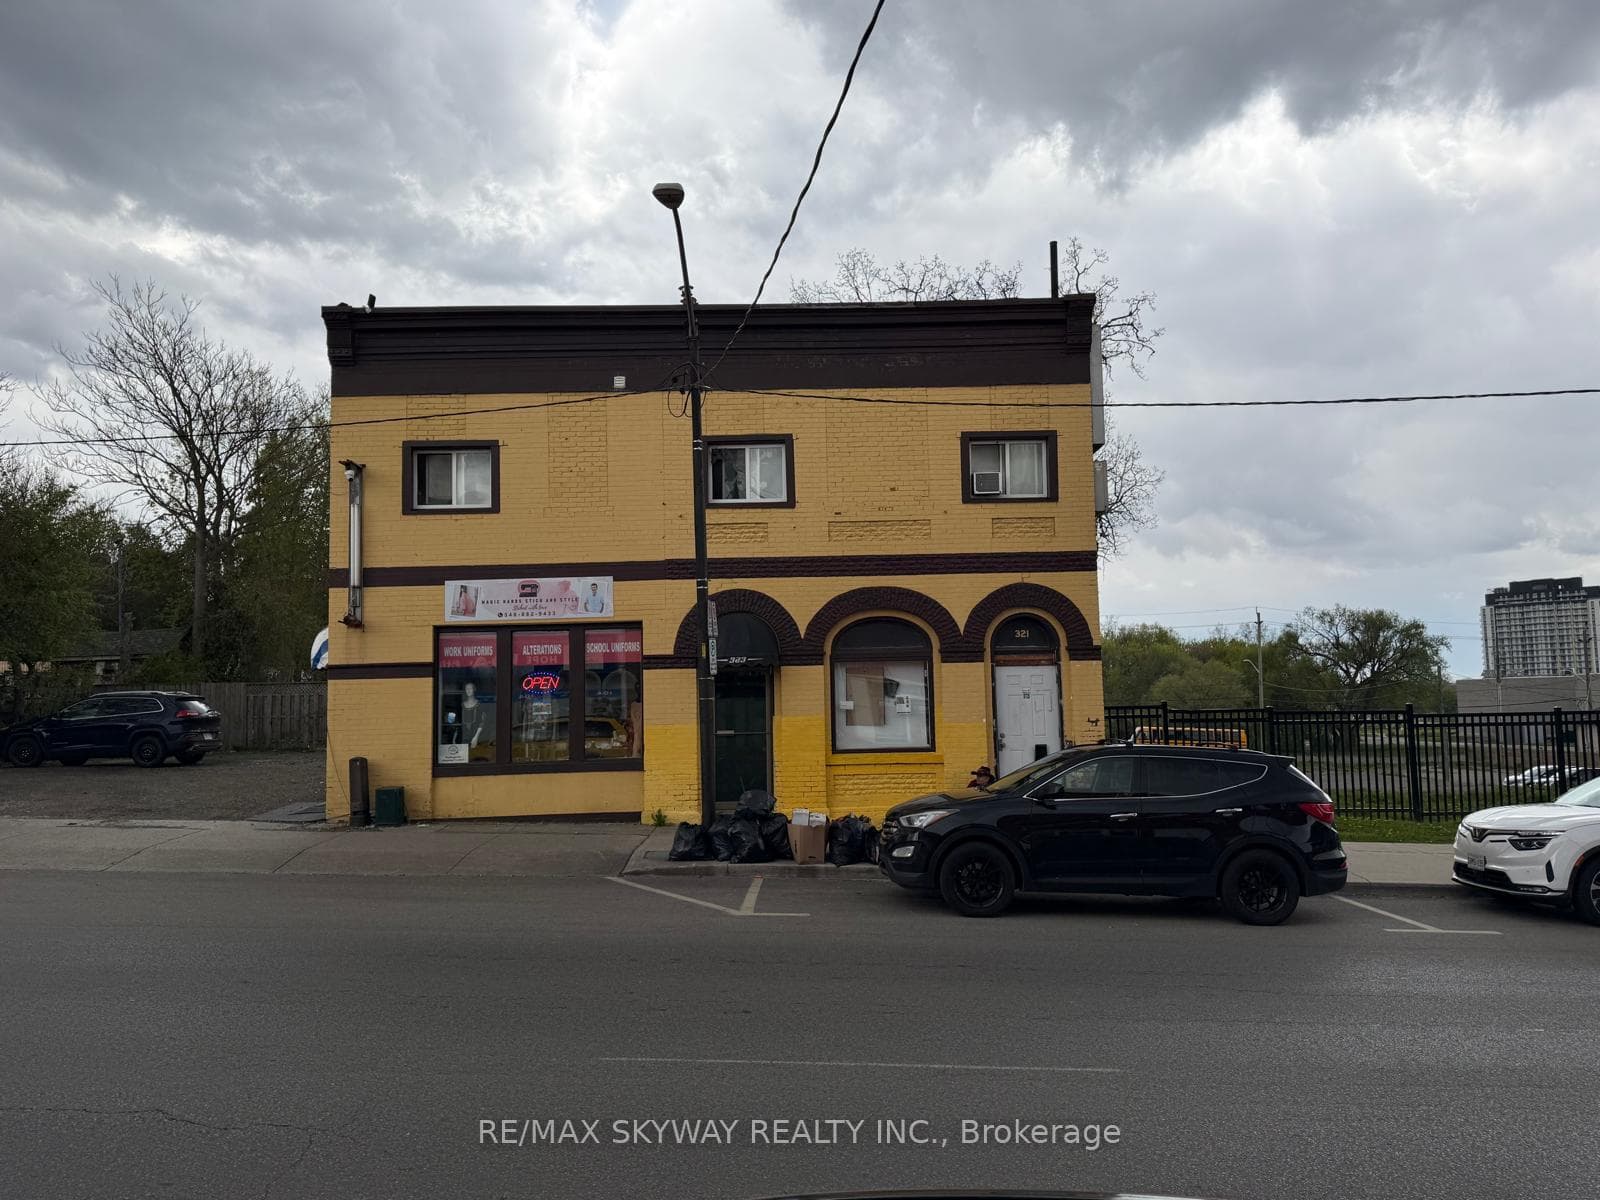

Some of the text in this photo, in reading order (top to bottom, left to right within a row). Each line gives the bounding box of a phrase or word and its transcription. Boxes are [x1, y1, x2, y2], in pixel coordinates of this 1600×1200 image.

[1014, 629, 1029, 638] 321
[443, 645, 493, 656] WORK UNIFORMS
[522, 644, 562, 655] ALTERATIONS
[586, 641, 640, 653] SCHOOL UNIFORMS
[522, 676, 560, 690] OPEN
